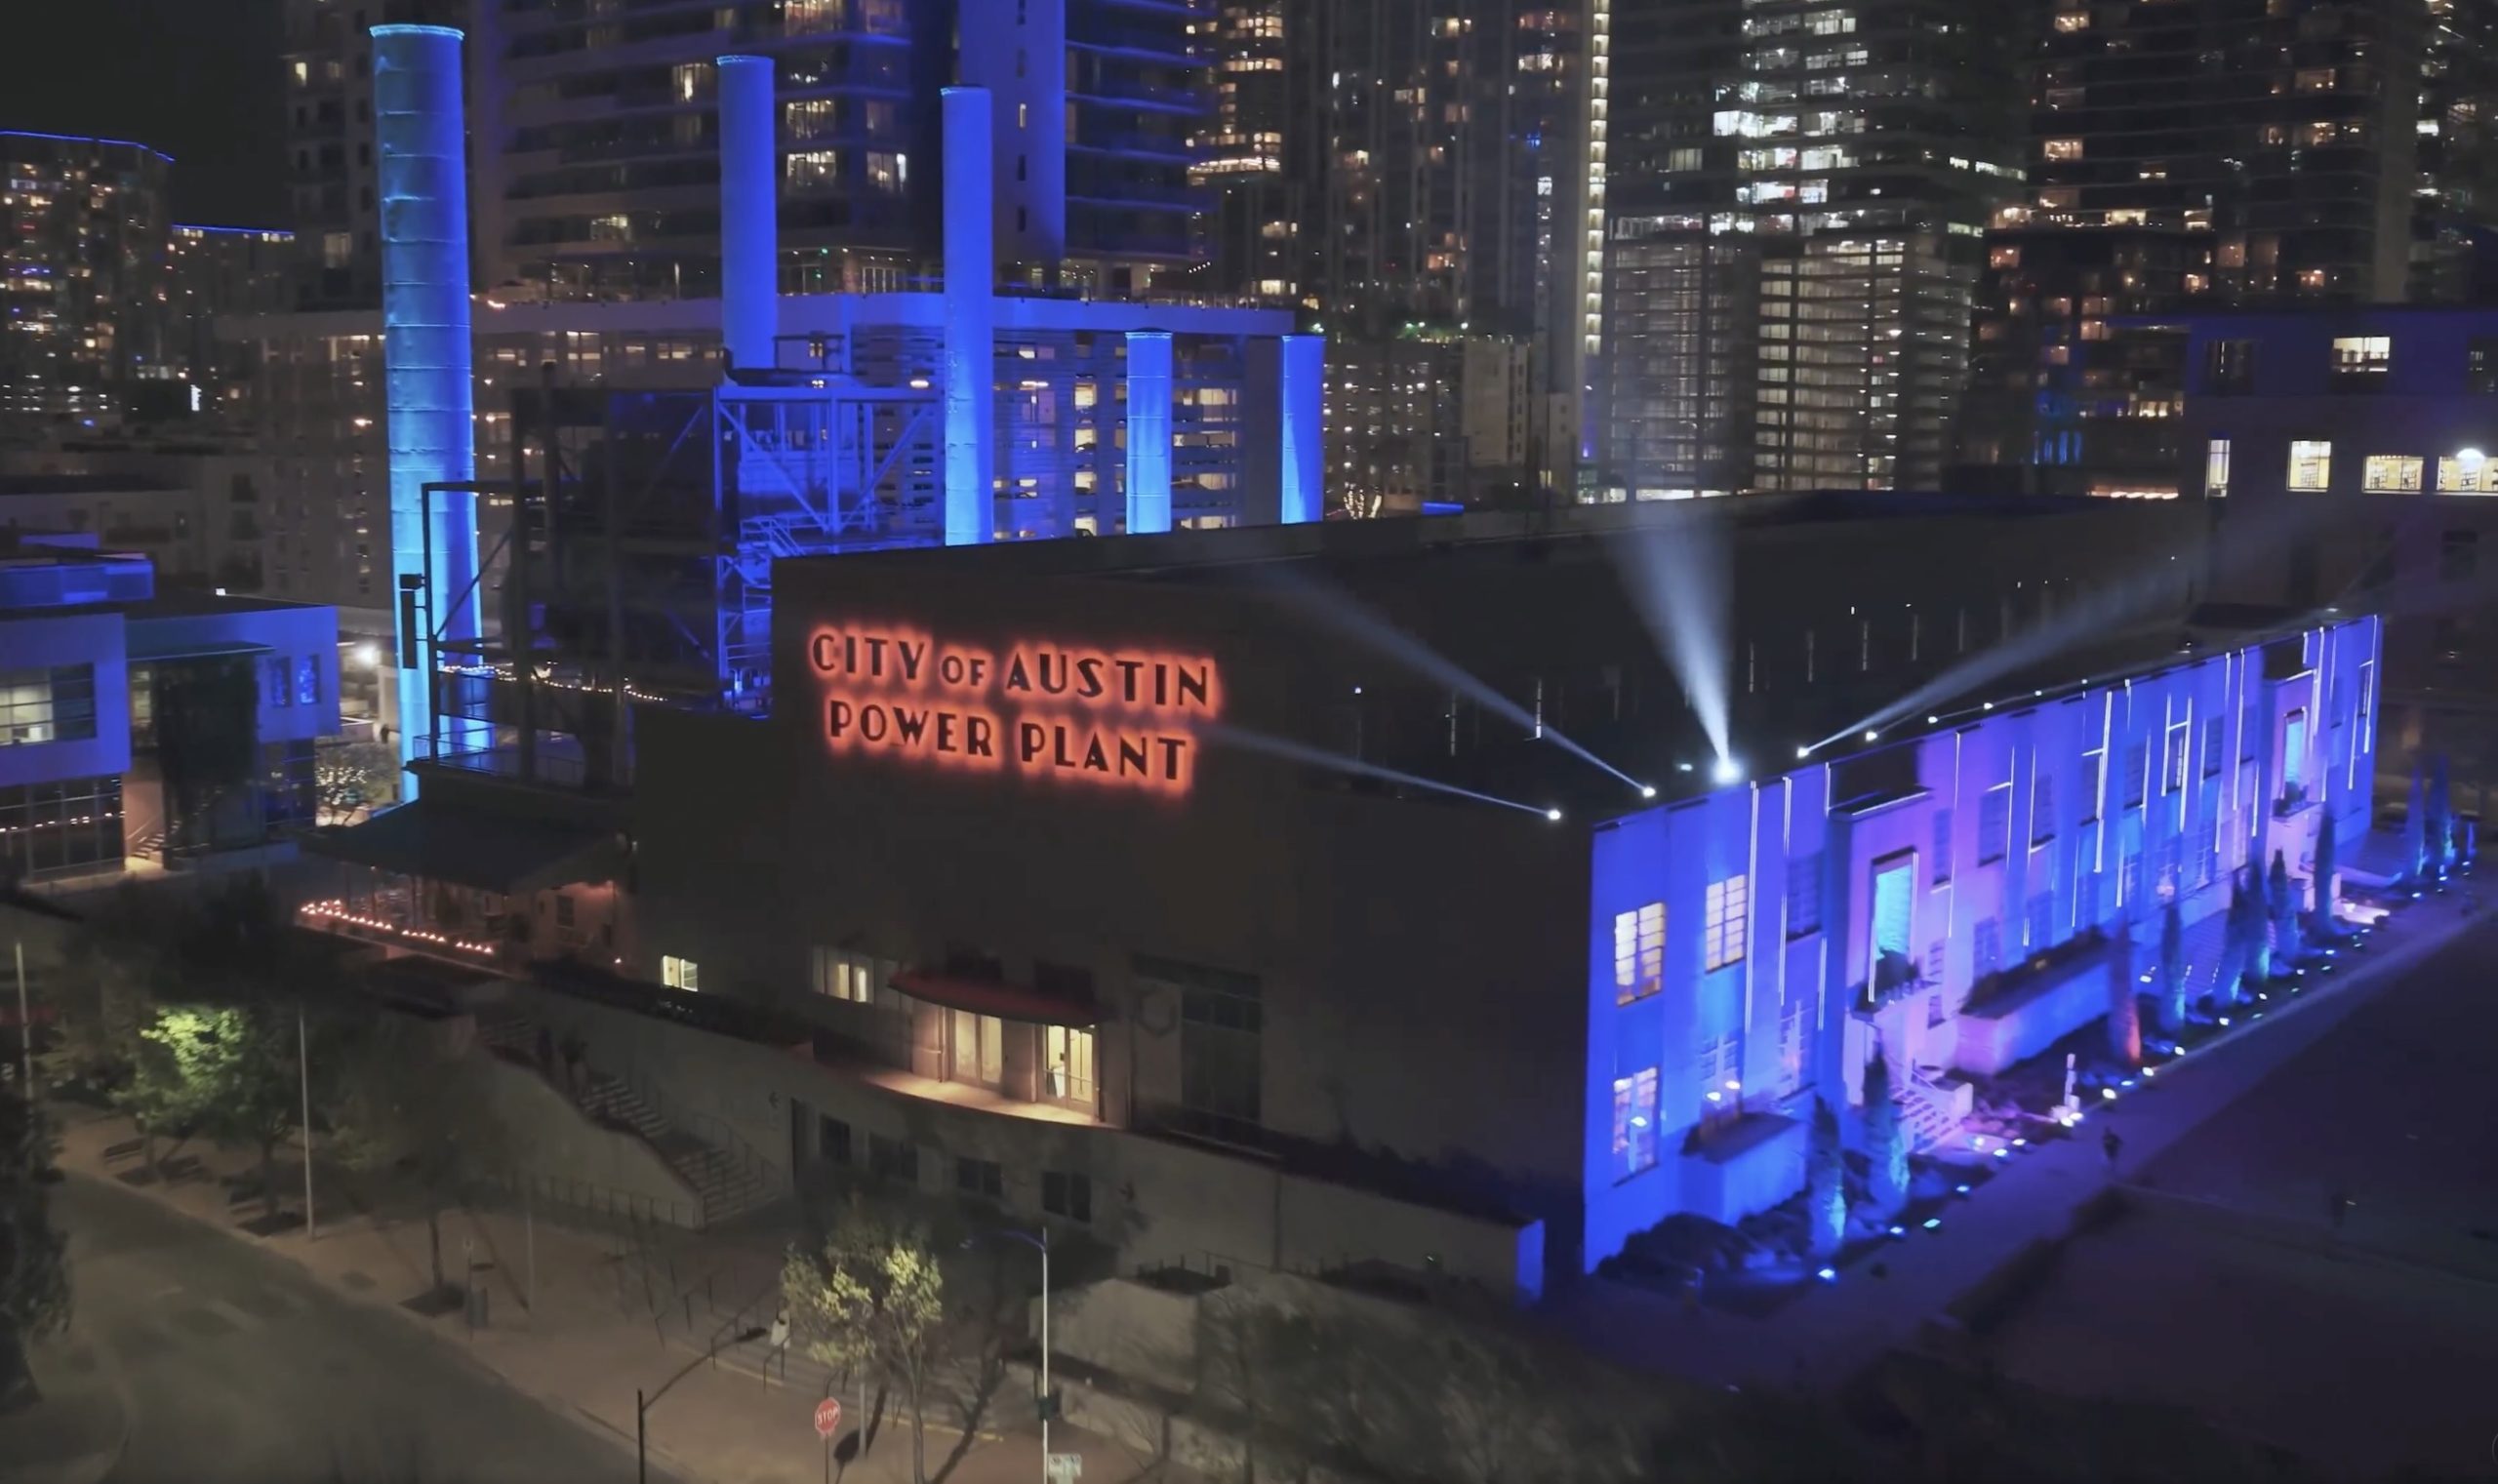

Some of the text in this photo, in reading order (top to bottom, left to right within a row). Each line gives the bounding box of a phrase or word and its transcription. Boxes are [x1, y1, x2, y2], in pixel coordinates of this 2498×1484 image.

[812, 633, 1208, 706] CITY OF AUSTIN
[829, 700, 1188, 781] POWER PLANT
[817, 1407, 838, 1424] STOP
